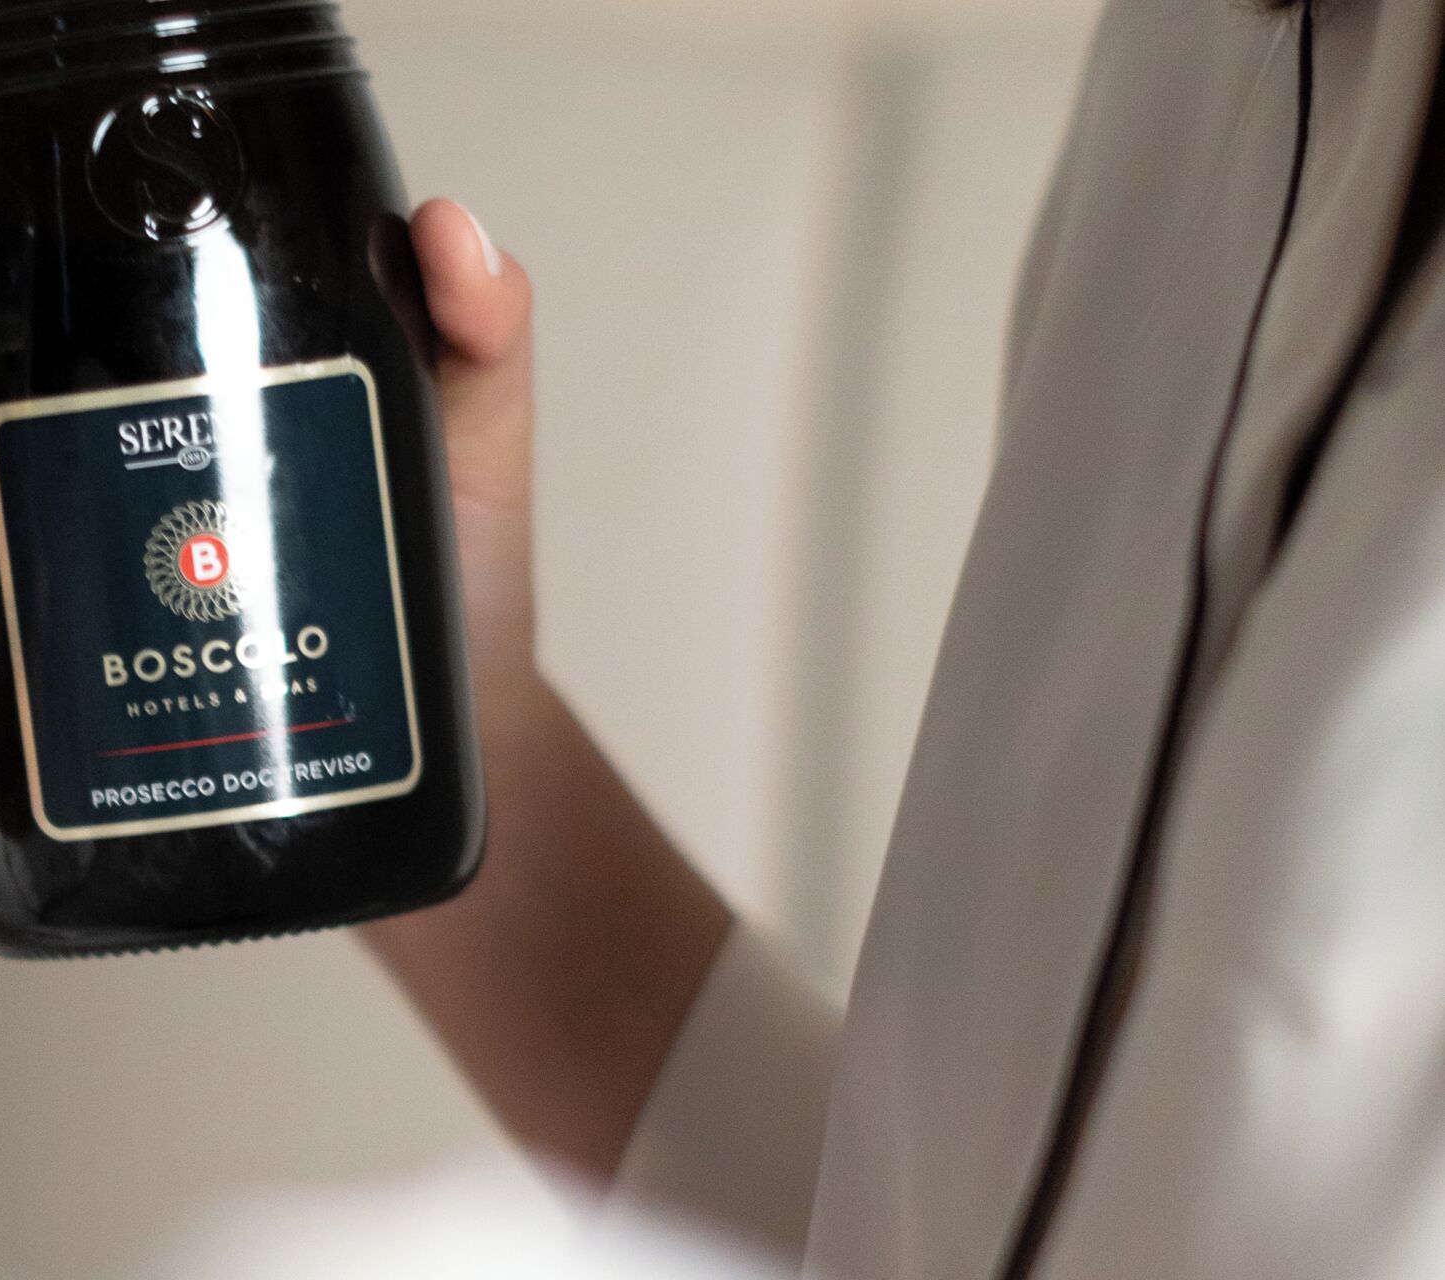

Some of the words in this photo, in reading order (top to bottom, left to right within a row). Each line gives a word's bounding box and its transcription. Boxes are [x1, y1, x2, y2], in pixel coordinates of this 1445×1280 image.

[118, 410, 247, 456] SERE
[190, 541, 223, 581] B
[126, 691, 220, 718] HOTELS
[234, 687, 247, 704] &
[260, 676, 318, 700] AS
[91, 776, 215, 809] PROSECCO
[222, 768, 275, 793] DOC
